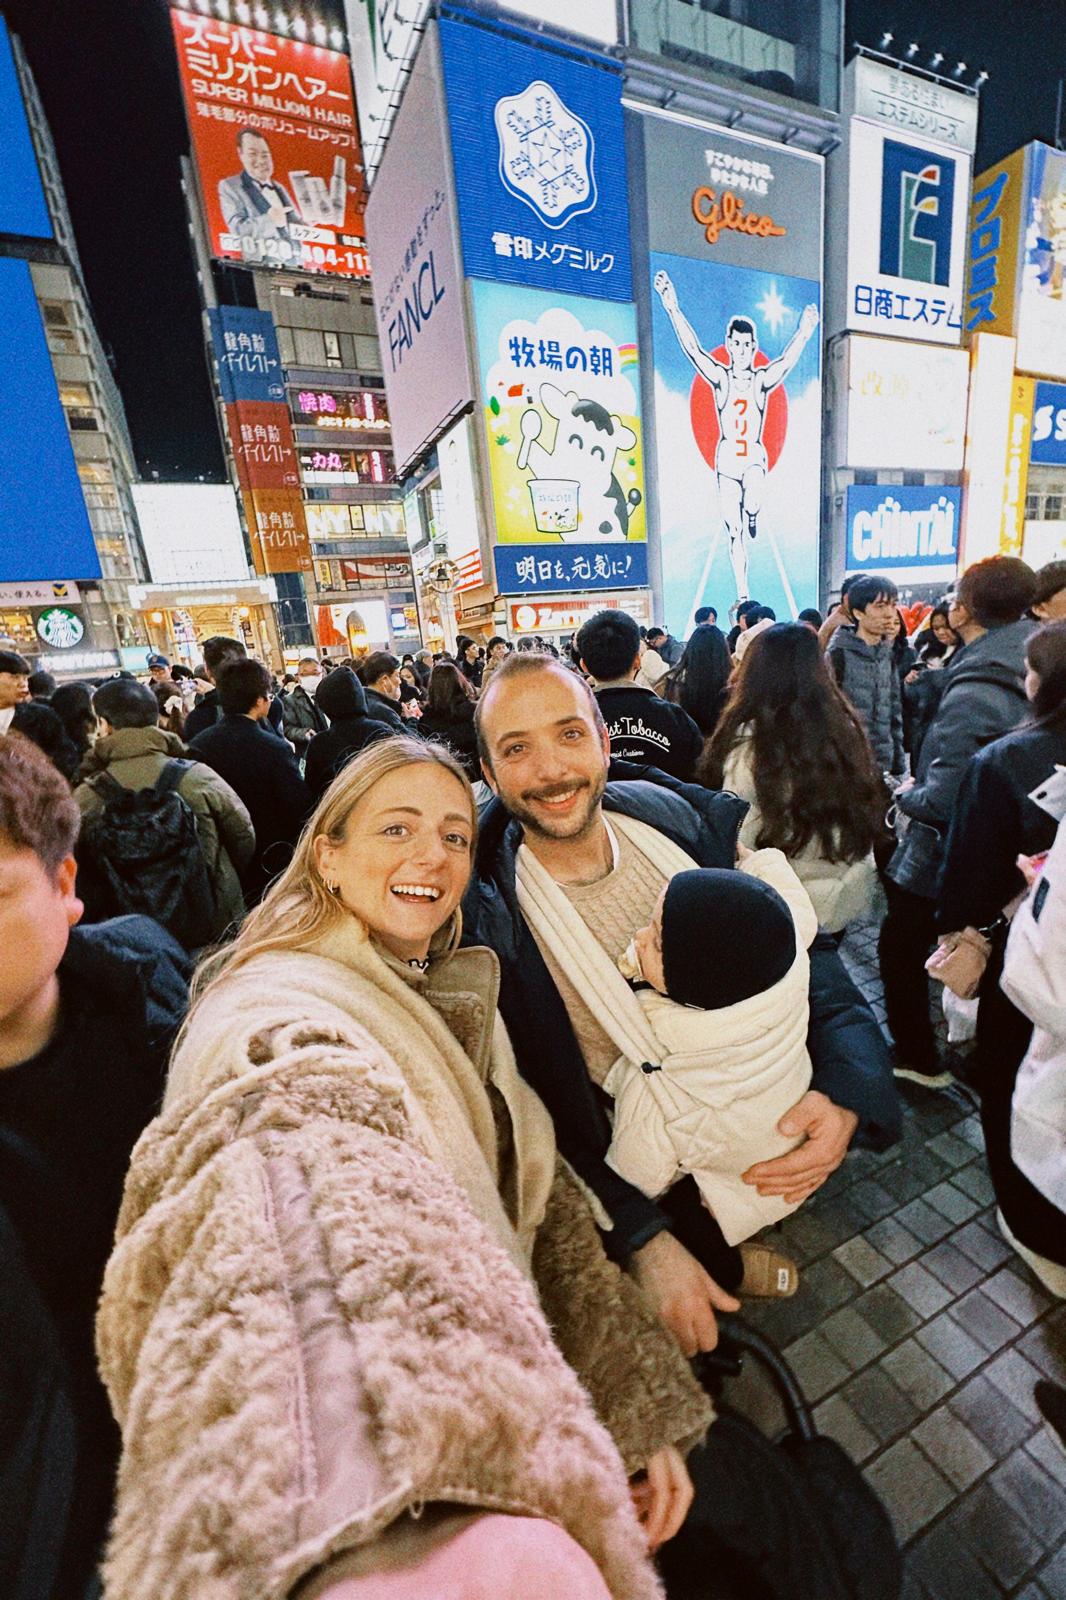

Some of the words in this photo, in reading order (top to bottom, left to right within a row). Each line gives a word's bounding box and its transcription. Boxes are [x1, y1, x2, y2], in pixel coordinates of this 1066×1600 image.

[177, 11, 277, 60] スーパー
[185, 48, 349, 100] ミリオンヘアー
[192, 78, 248, 103] SUPER
[252, 92, 310, 117] MILLION
[314, 107, 352, 127] HAIR
[692, 186, 787, 244] Glico
[491, 231, 614, 273] 雪印メグミルク
[388, 250, 445, 373] FANCL
[854, 284, 962, 329] 日商エステム
[509, 336, 613, 378] 牧場の朝
[515, 554, 632, 584] 明日を、元気に!
[620, 717, 671, 746] Tobacco
